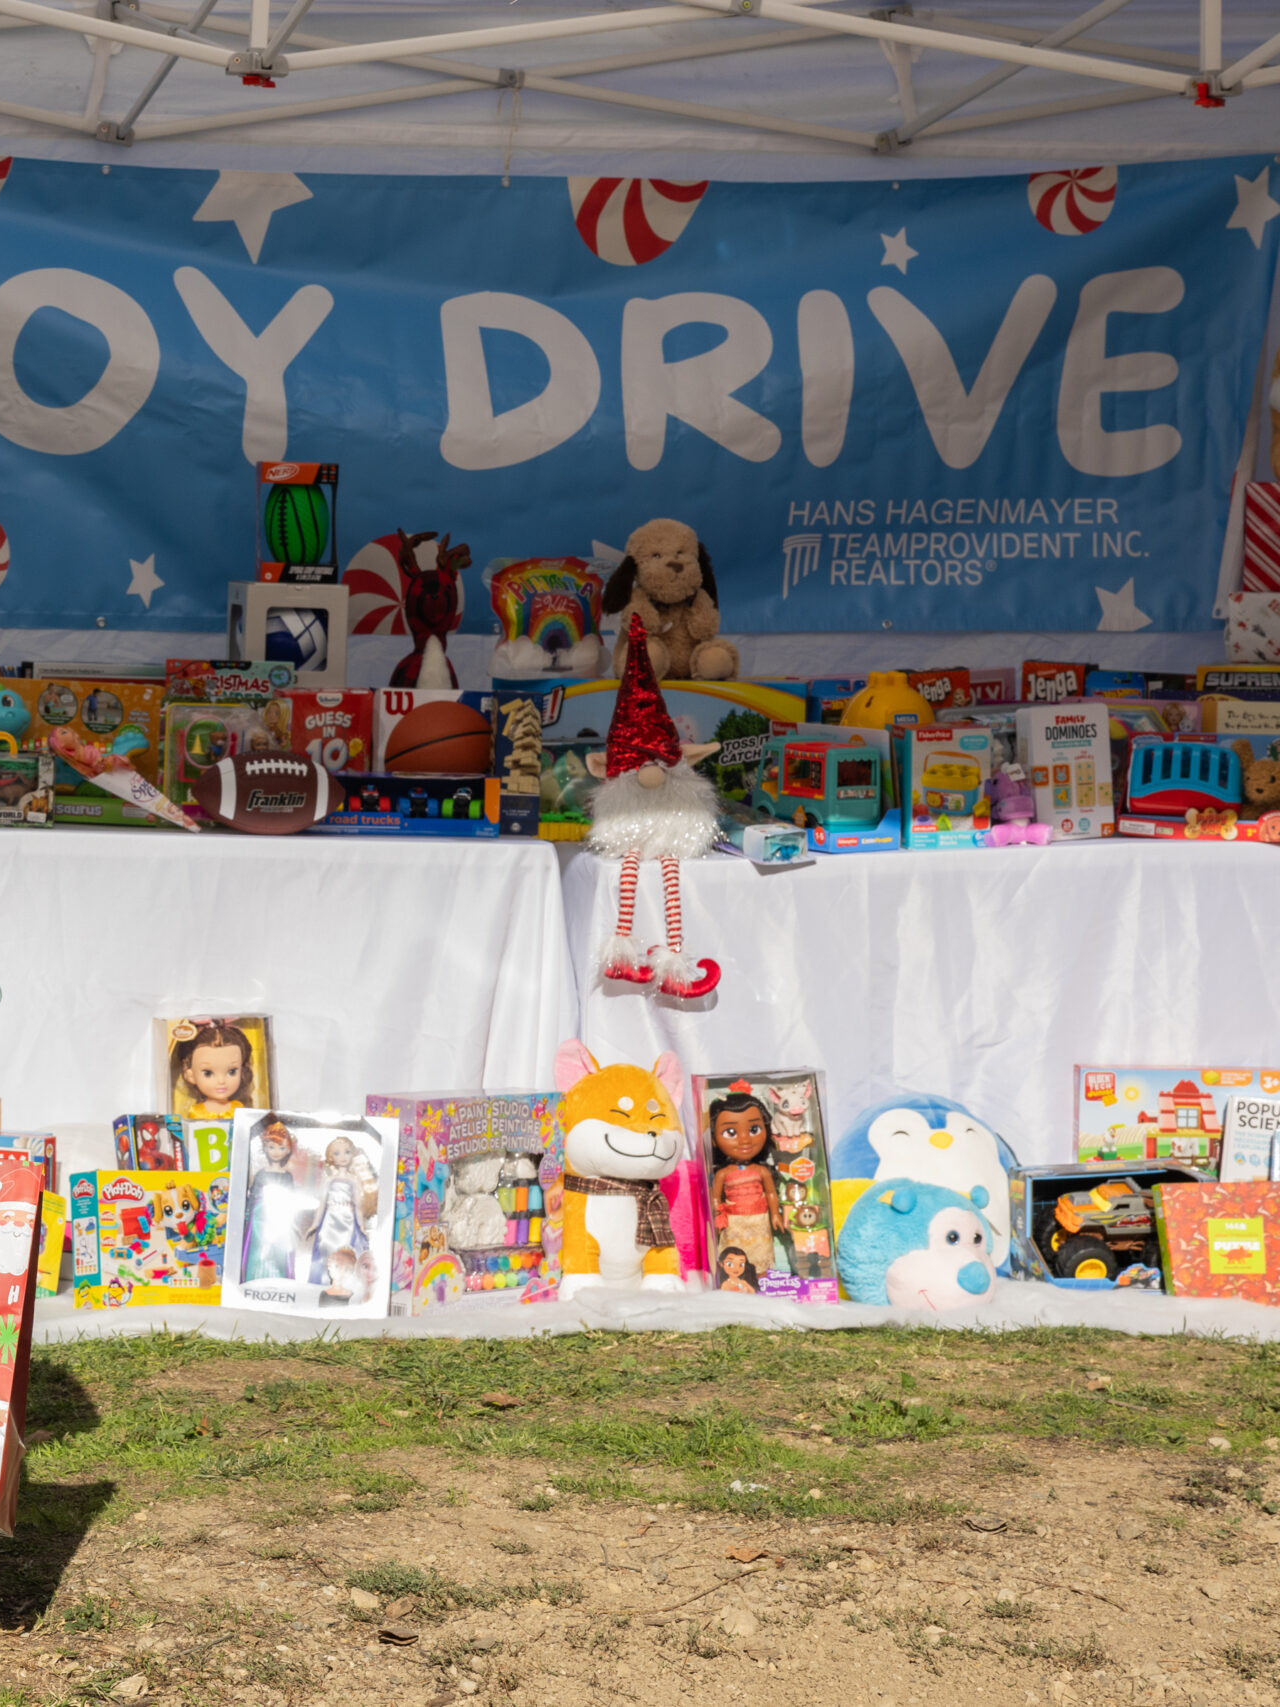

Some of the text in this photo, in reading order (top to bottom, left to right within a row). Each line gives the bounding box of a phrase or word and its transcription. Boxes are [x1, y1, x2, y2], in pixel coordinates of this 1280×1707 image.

[440, 266, 1185, 477] DRIVE
[788, 497, 1119, 526] HANS HAGENMAYER
[828, 530, 1151, 560] TEAMPROVIDENT INC.
[200, 672, 271, 694] RISTMAS
[1027, 670, 1078, 702] Jenga
[305, 711, 353, 730] GUESS
[1055, 715, 1086, 725] FAMILY
[322, 726, 336, 738] IN
[1046, 724, 1097, 741] DOMINOES
[723, 736, 757, 751] TOSS
[305, 738, 349, 771] 10
[329, 814, 401, 825] road trucks
[1263, 1076, 1280, 1089] 3+
[459, 1100, 530, 1121] PAINT STUDIO
[449, 1119, 541, 1141] ATELIER PEINTURE
[447, 1138, 489, 1158] ESTUDIO
[501, 1135, 544, 1153] PINTURA
[102, 1180, 144, 1200] Play-Doh
[243, 1288, 297, 1304] FROZEN
